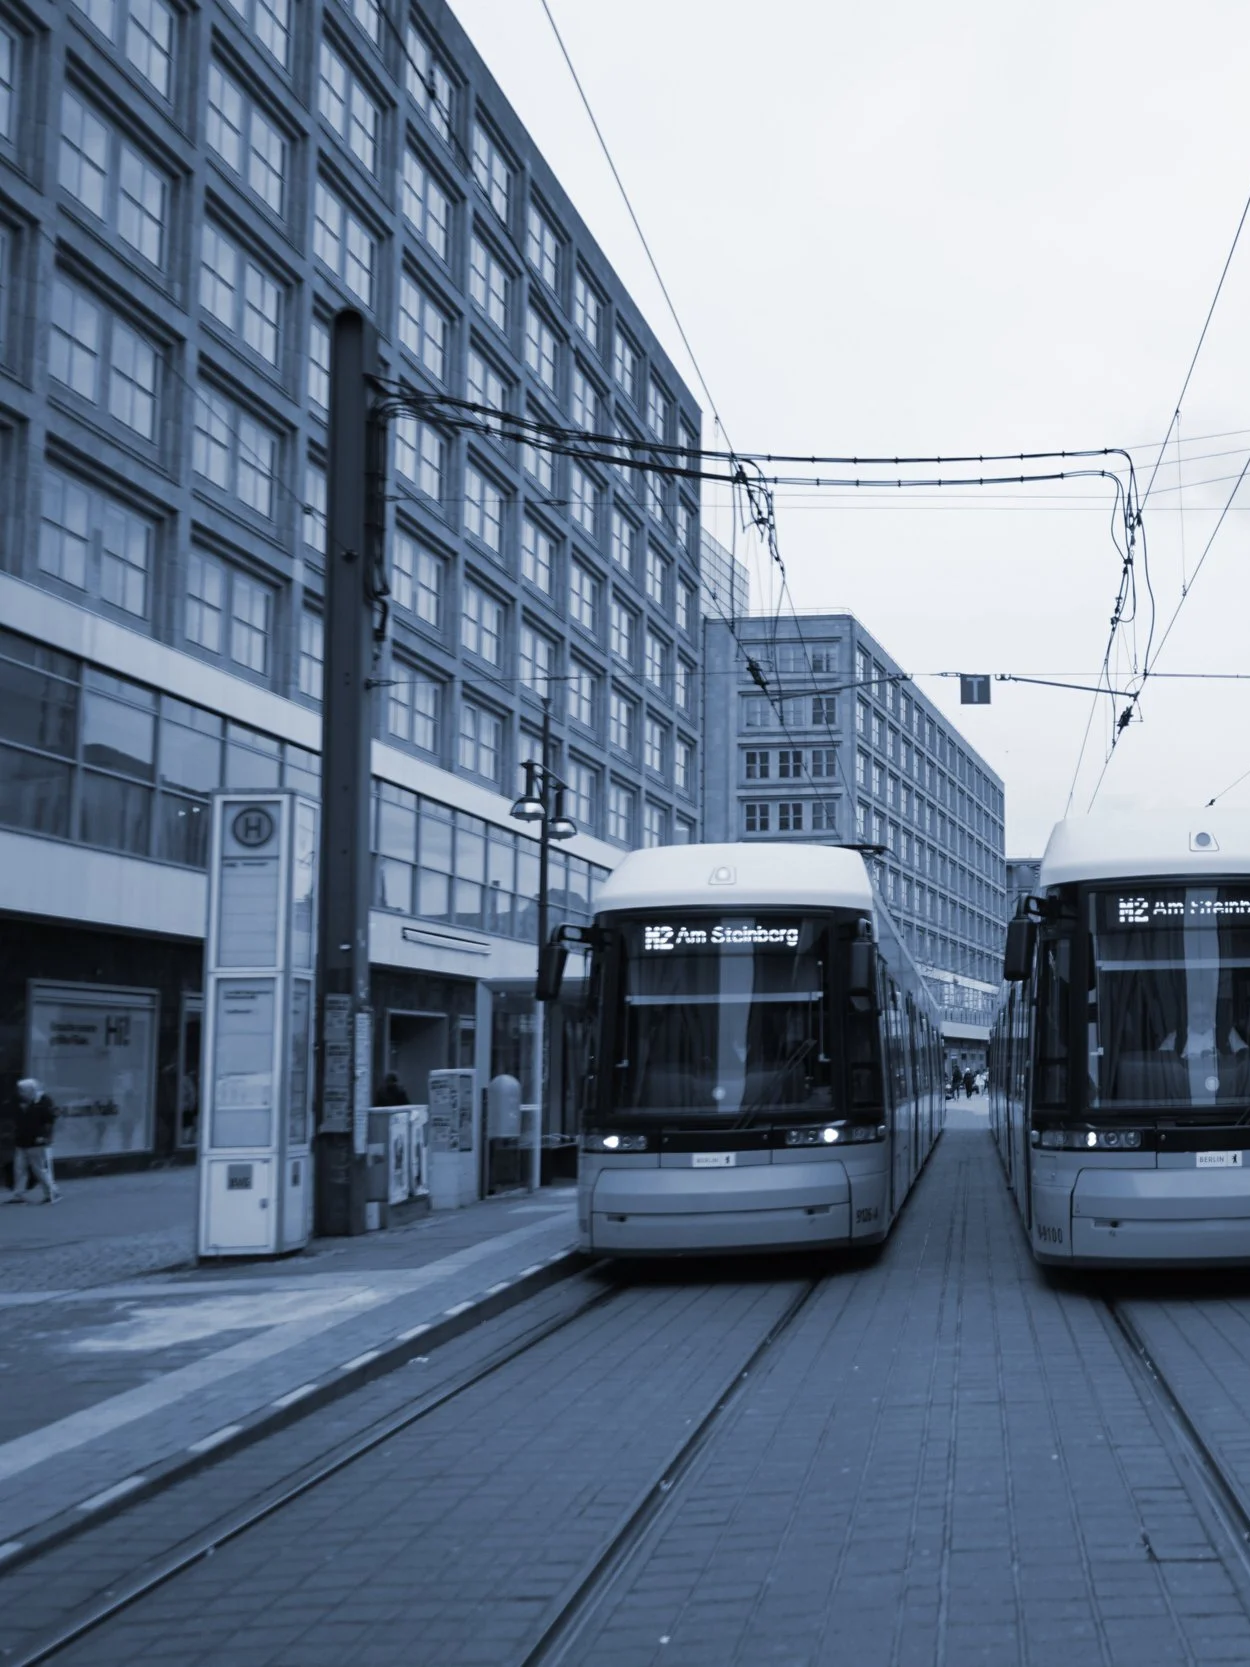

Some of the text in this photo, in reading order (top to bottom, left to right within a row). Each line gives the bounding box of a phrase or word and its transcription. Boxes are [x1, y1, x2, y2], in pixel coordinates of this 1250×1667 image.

[1118, 898, 1149, 922] M2
[1152, 902, 1184, 915] Am
[645, 926, 799, 950] M2 Am Steinberg
[1199, 1155, 1225, 1164] BERLIN
